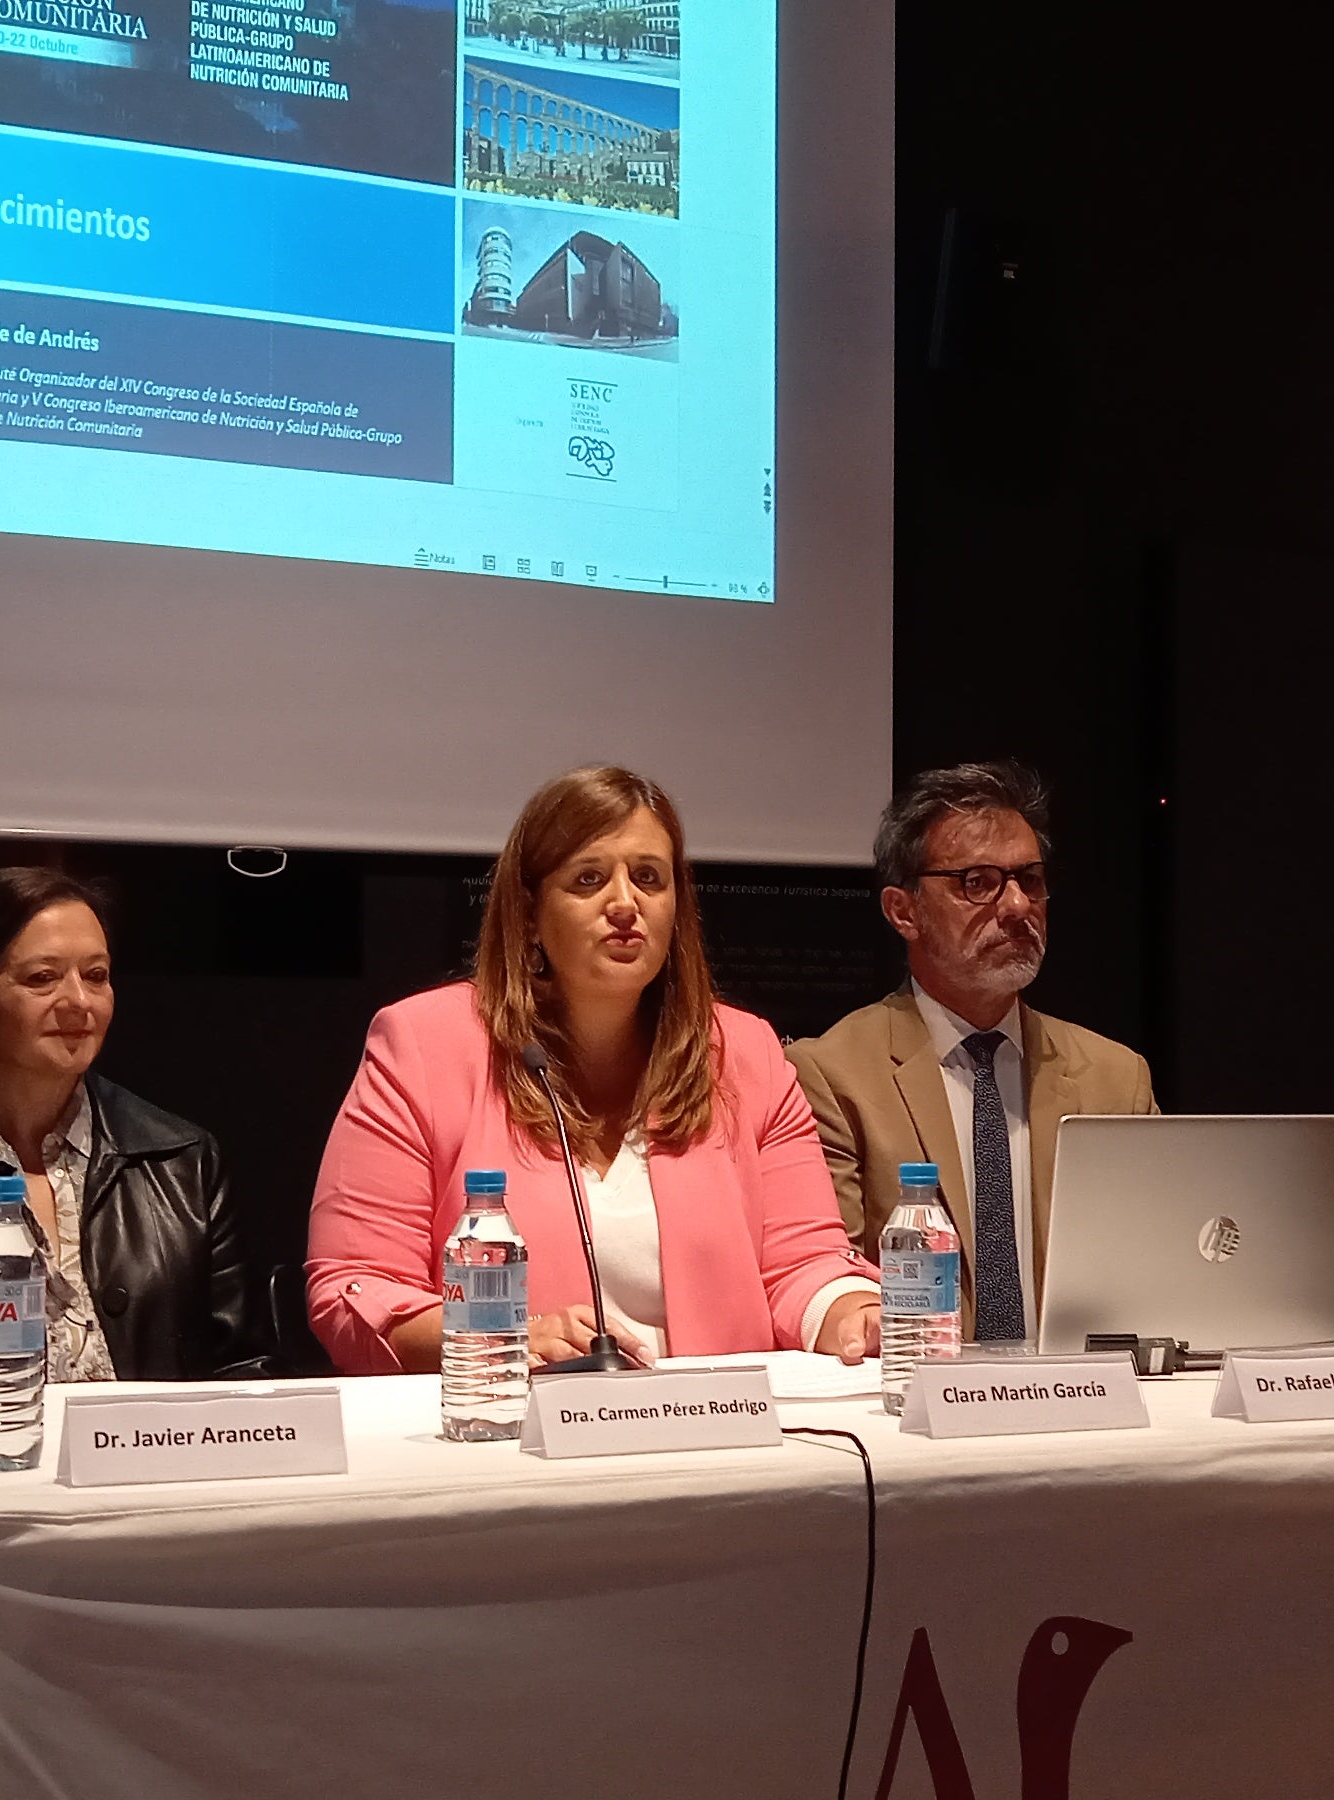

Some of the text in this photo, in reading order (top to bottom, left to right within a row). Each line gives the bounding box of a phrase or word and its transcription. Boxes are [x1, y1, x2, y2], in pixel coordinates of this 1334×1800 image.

[191, 1, 208, 17] DE
[212, 5, 279, 28] NUTRICIÓN
[283, 14, 292, 30] Y
[295, 16, 336, 37] SALUD
[29, 33, 79, 55] Octubre
[190, 20, 294, 51] PÚBLICA-GRUPO
[190, 43, 330, 78] LATINOAMERICANO DE
[190, 64, 349, 101] NUTRICIÓN COMUNITARIA
[13, 324, 35, 345] de
[39, 331, 100, 351] Andrés
[19, 368, 97, 390] Organizador
[99, 375, 118, 392] del
[119, 377, 142, 393] XIV
[143, 381, 199, 401] Congreso
[202, 386, 217, 403] de
[220, 388, 232, 405] la
[233, 391, 287, 410] Sociedad
[288, 398, 341, 416] Española
[344, 403, 359, 418] de
[570, 384, 612, 403] SENC
[6, 412, 64, 430] Nutrición
[67, 417, 143, 438] Comunitaria
[20, 392, 30, 407] y
[32, 392, 43, 406] V
[43, 392, 102, 415] Congreso
[104, 398, 199, 423] Iberoamericano
[201, 409, 217, 425] de
[219, 412, 273, 431] Nutrición
[276, 420, 284, 435] y
[286, 419, 318, 436] Salud
[320, 422, 403, 446] Pública-Grupo
[943, 1380, 1107, 1403] Clara Martín García
[1256, 1377, 1282, 1393] Dr.
[561, 1398, 768, 1424] Dra. Carmen Pérez Rodrigo
[94, 1424, 296, 1448] Dr. Javier Aranceta
